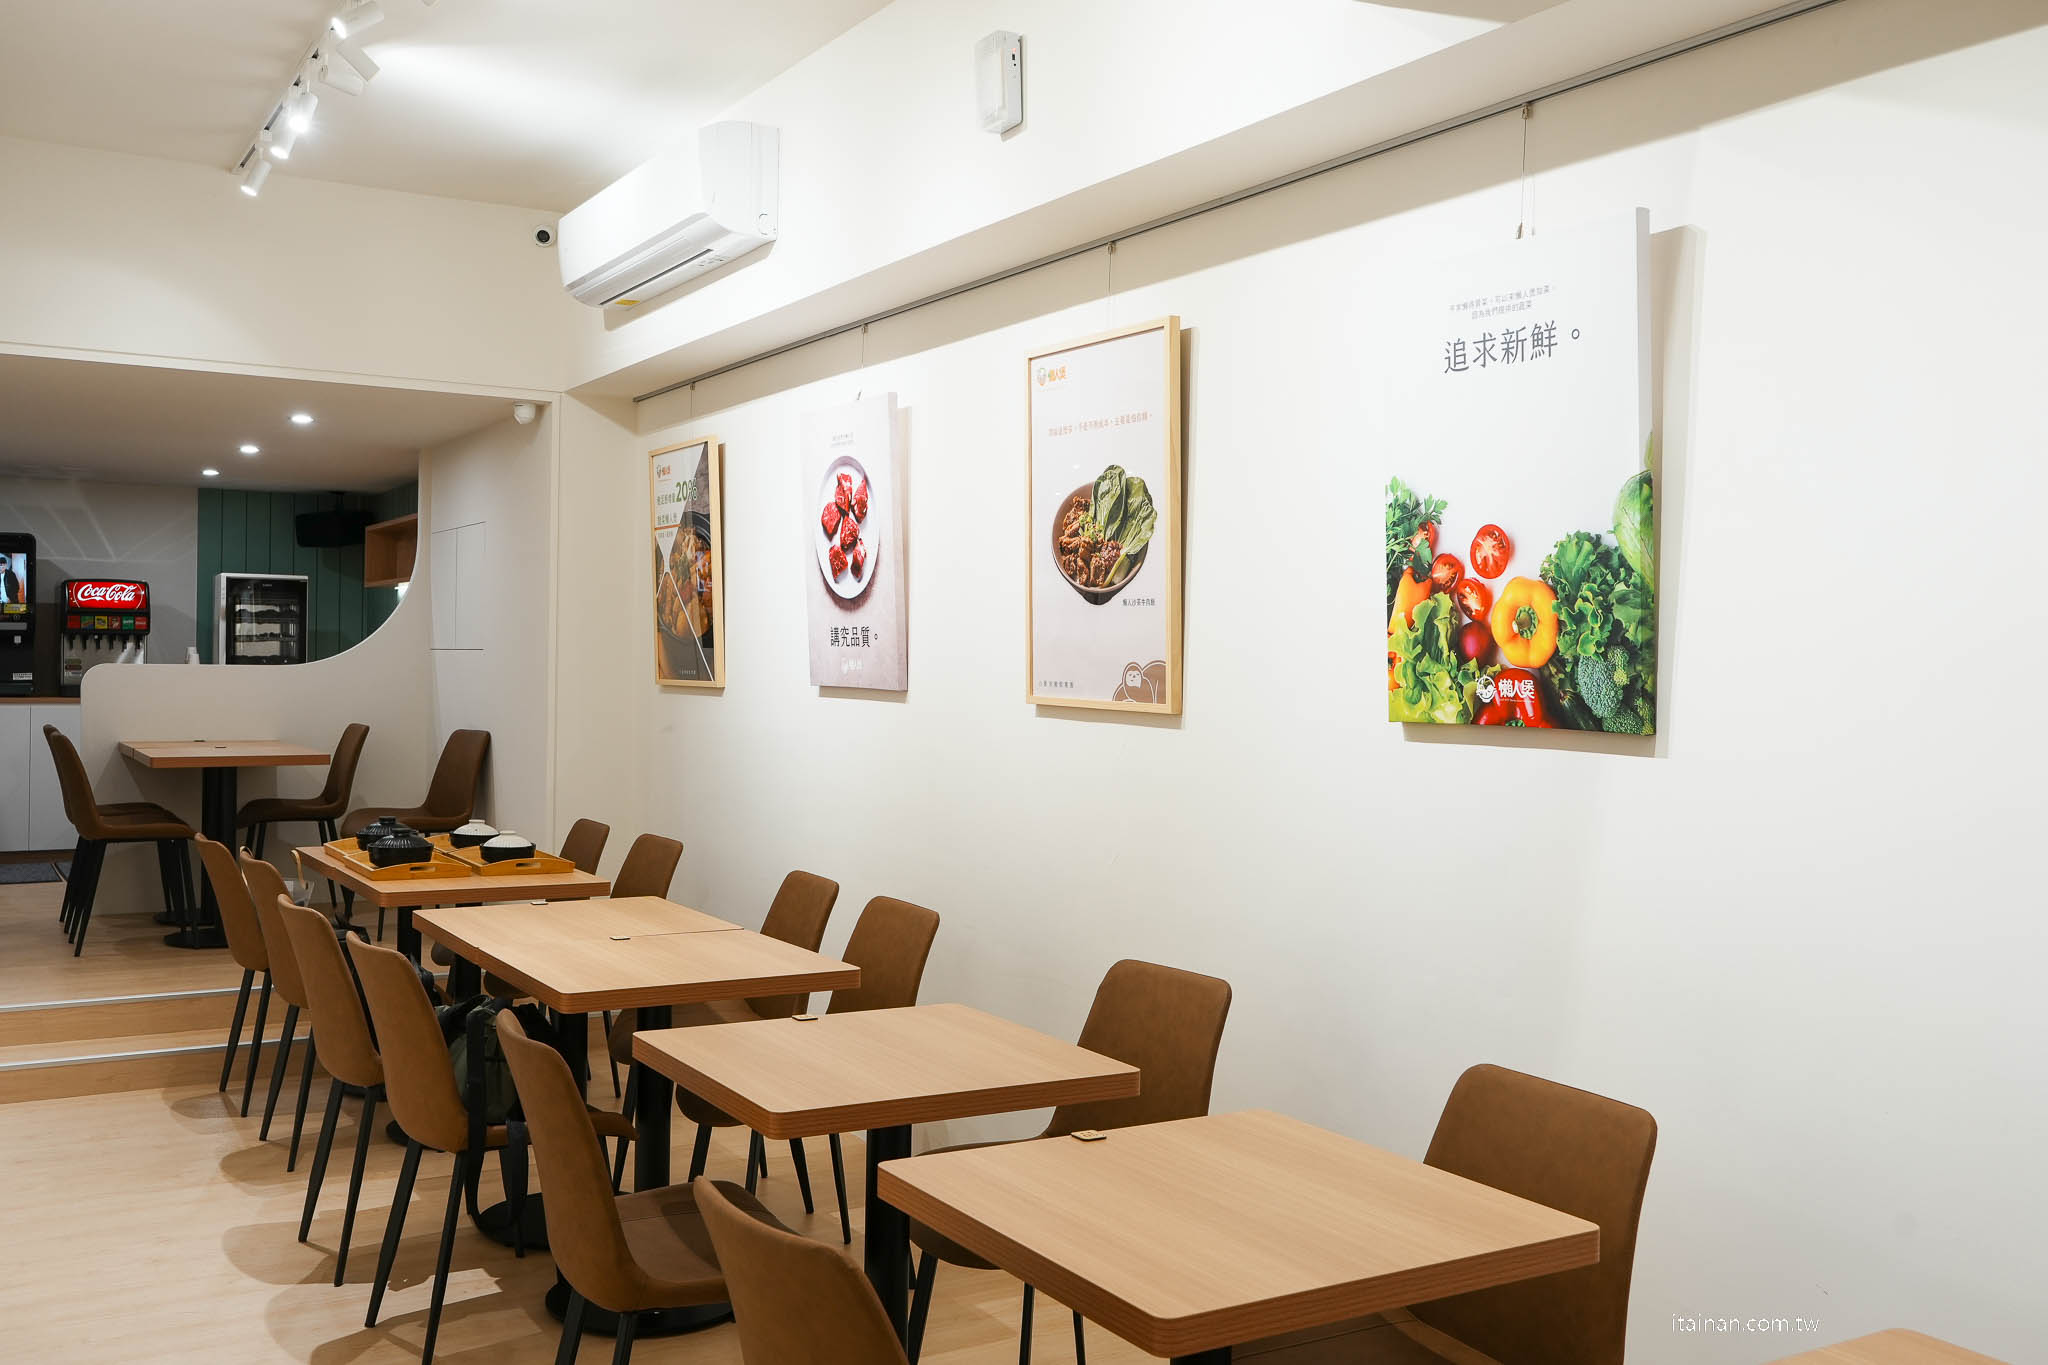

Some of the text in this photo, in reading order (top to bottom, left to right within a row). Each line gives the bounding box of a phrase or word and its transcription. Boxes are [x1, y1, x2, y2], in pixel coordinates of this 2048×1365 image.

[1444, 319, 1581, 374] 追求新鮮。
[77, 583, 138, 602] Coca-Cola
[830, 625, 879, 648] 講究品質。
[1498, 678, 1536, 700] 懶人煲
